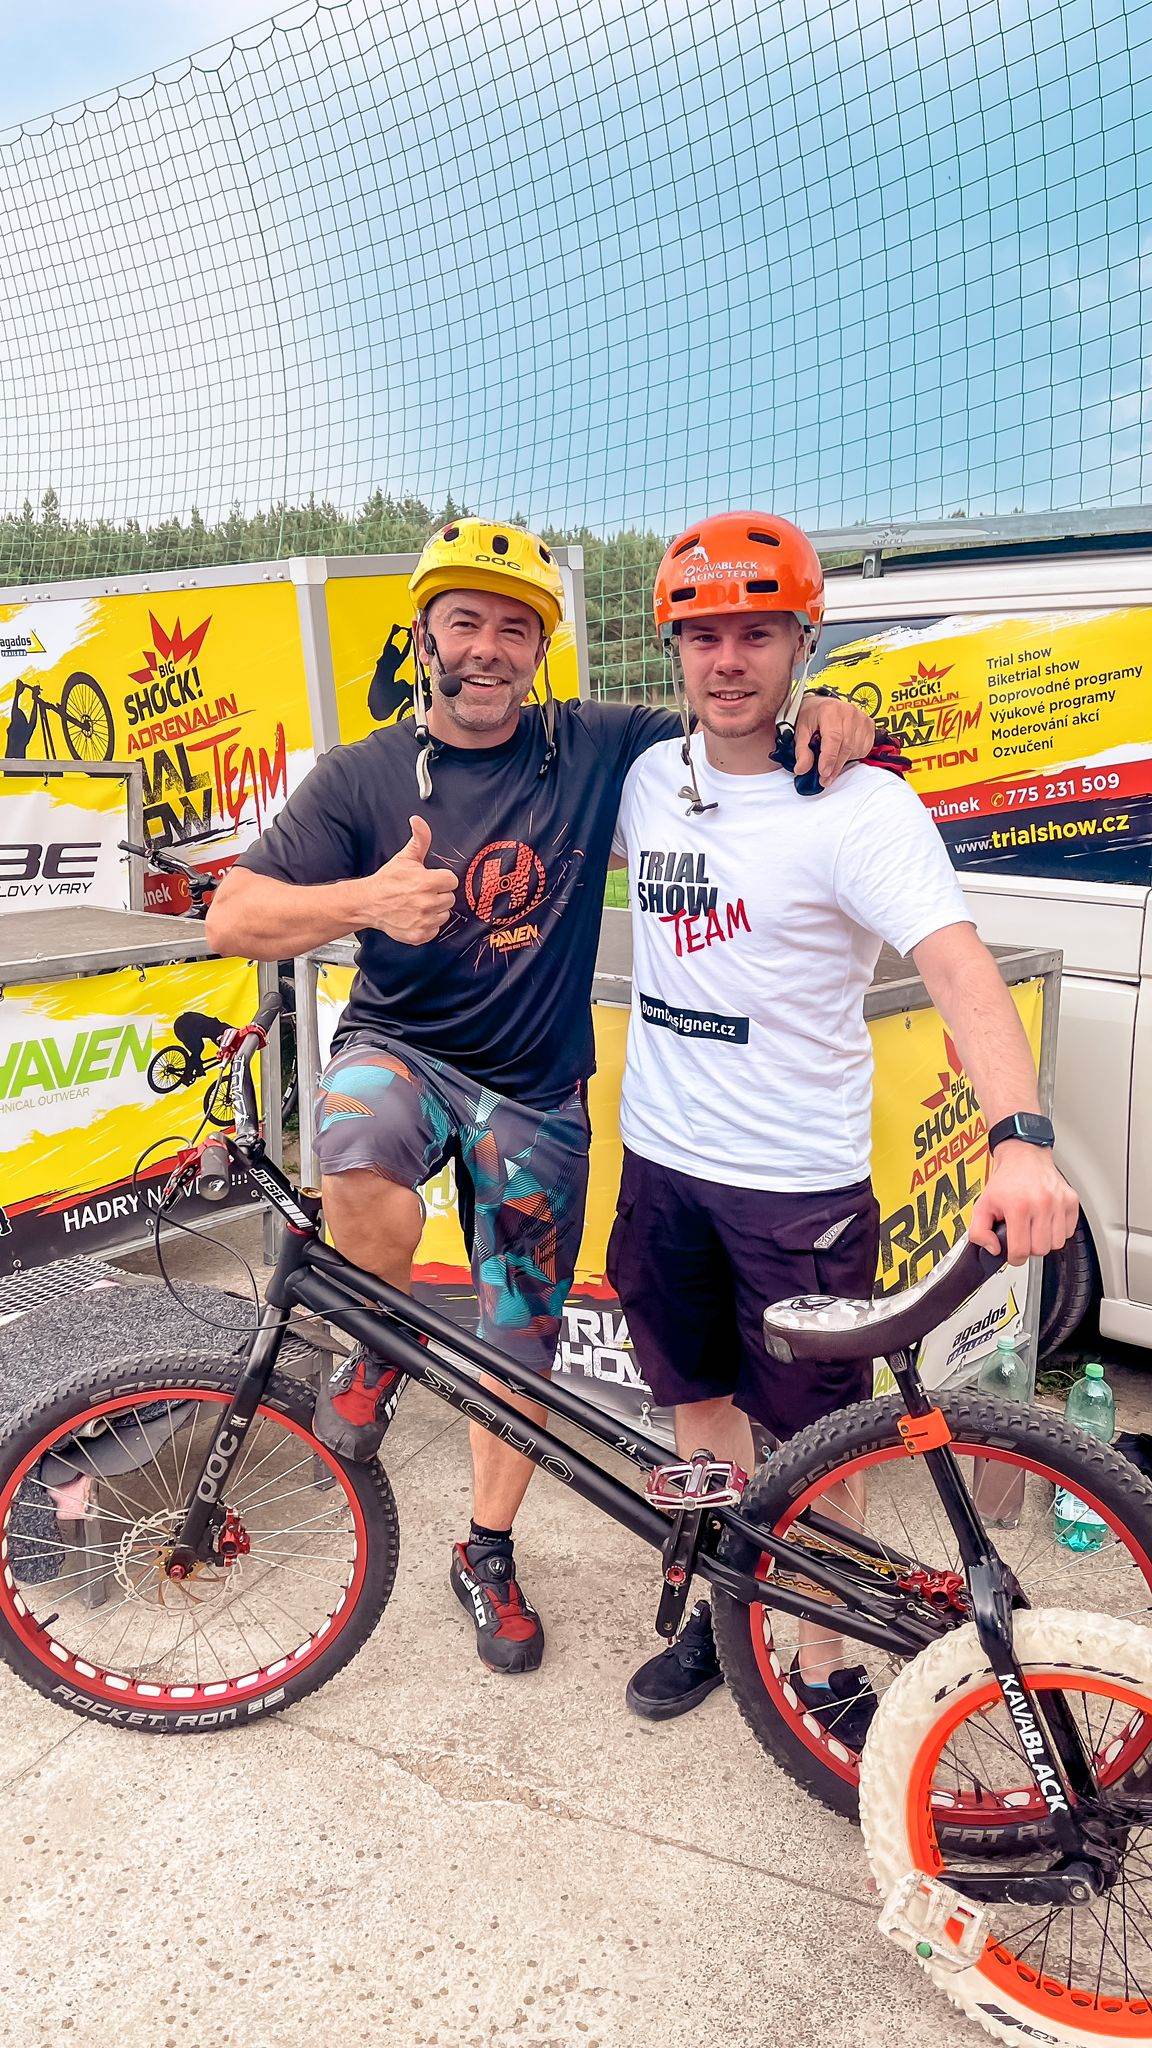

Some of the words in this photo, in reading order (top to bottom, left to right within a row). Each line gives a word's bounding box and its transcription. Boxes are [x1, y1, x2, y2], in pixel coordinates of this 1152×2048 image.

[684, 572, 723, 585] RACING
[727, 570, 758, 579] TEAM
[0, 635, 31, 649] agados
[986, 653, 1014, 669] Trial
[1018, 647, 1052, 663] show
[159, 660, 176, 677] BIG
[988, 666, 1041, 687] Biketrial
[1045, 660, 1080, 675] show
[989, 677, 1071, 705] Doprovodné
[1075, 665, 1143, 690] programy
[124, 666, 204, 726] SHOCK!
[887, 691, 960, 714] ADRENALIN
[891, 681, 941, 703] SHOCK!
[990, 702, 1045, 723] Výukové
[1050, 690, 1116, 713] programy
[127, 693, 239, 754] ADRENALIN
[874, 709, 935, 733] RIAL
[924, 701, 983, 744] TEAM
[992, 715, 1069, 740] Moderování
[1072, 708, 1100, 726] akcí
[908, 748, 978, 773] CTION
[993, 736, 1054, 758] Ozvučení
[136, 742, 212, 806] IAL
[186, 722, 288, 837] TEAM
[1006, 786, 1039, 806] 775
[1045, 780, 1076, 800] 231
[1082, 772, 1120, 793] 509
[143, 788, 213, 849] OW
[955, 814, 1130, 854] www.trialshow.cz
[0, 843, 101, 881] BE
[639, 850, 709, 884] TRIAL
[0, 885, 43, 898] OVY
[48, 882, 92, 895] VARY
[638, 882, 718, 917] SHOW
[489, 924, 538, 948] HAVEN
[659, 898, 752, 957] TEAM
[0, 1098, 35, 1114] HNICAL
[38, 1087, 90, 1106] OUTWEAR
[951, 1079, 966, 1097] BIG
[913, 1088, 980, 1161] SHOCK
[909, 1116, 989, 1195] ADRENA
[63, 1190, 142, 1234] HADRY
[880, 1158, 982, 1274] RIAL
[562, 1306, 634, 1350] RIA
[952, 1303, 1007, 1348] agados
[52, 1684, 165, 1728] ROCKET
[998, 1673, 1069, 1814] KAVABLACK
[941, 1827, 1006, 1844] FAT
